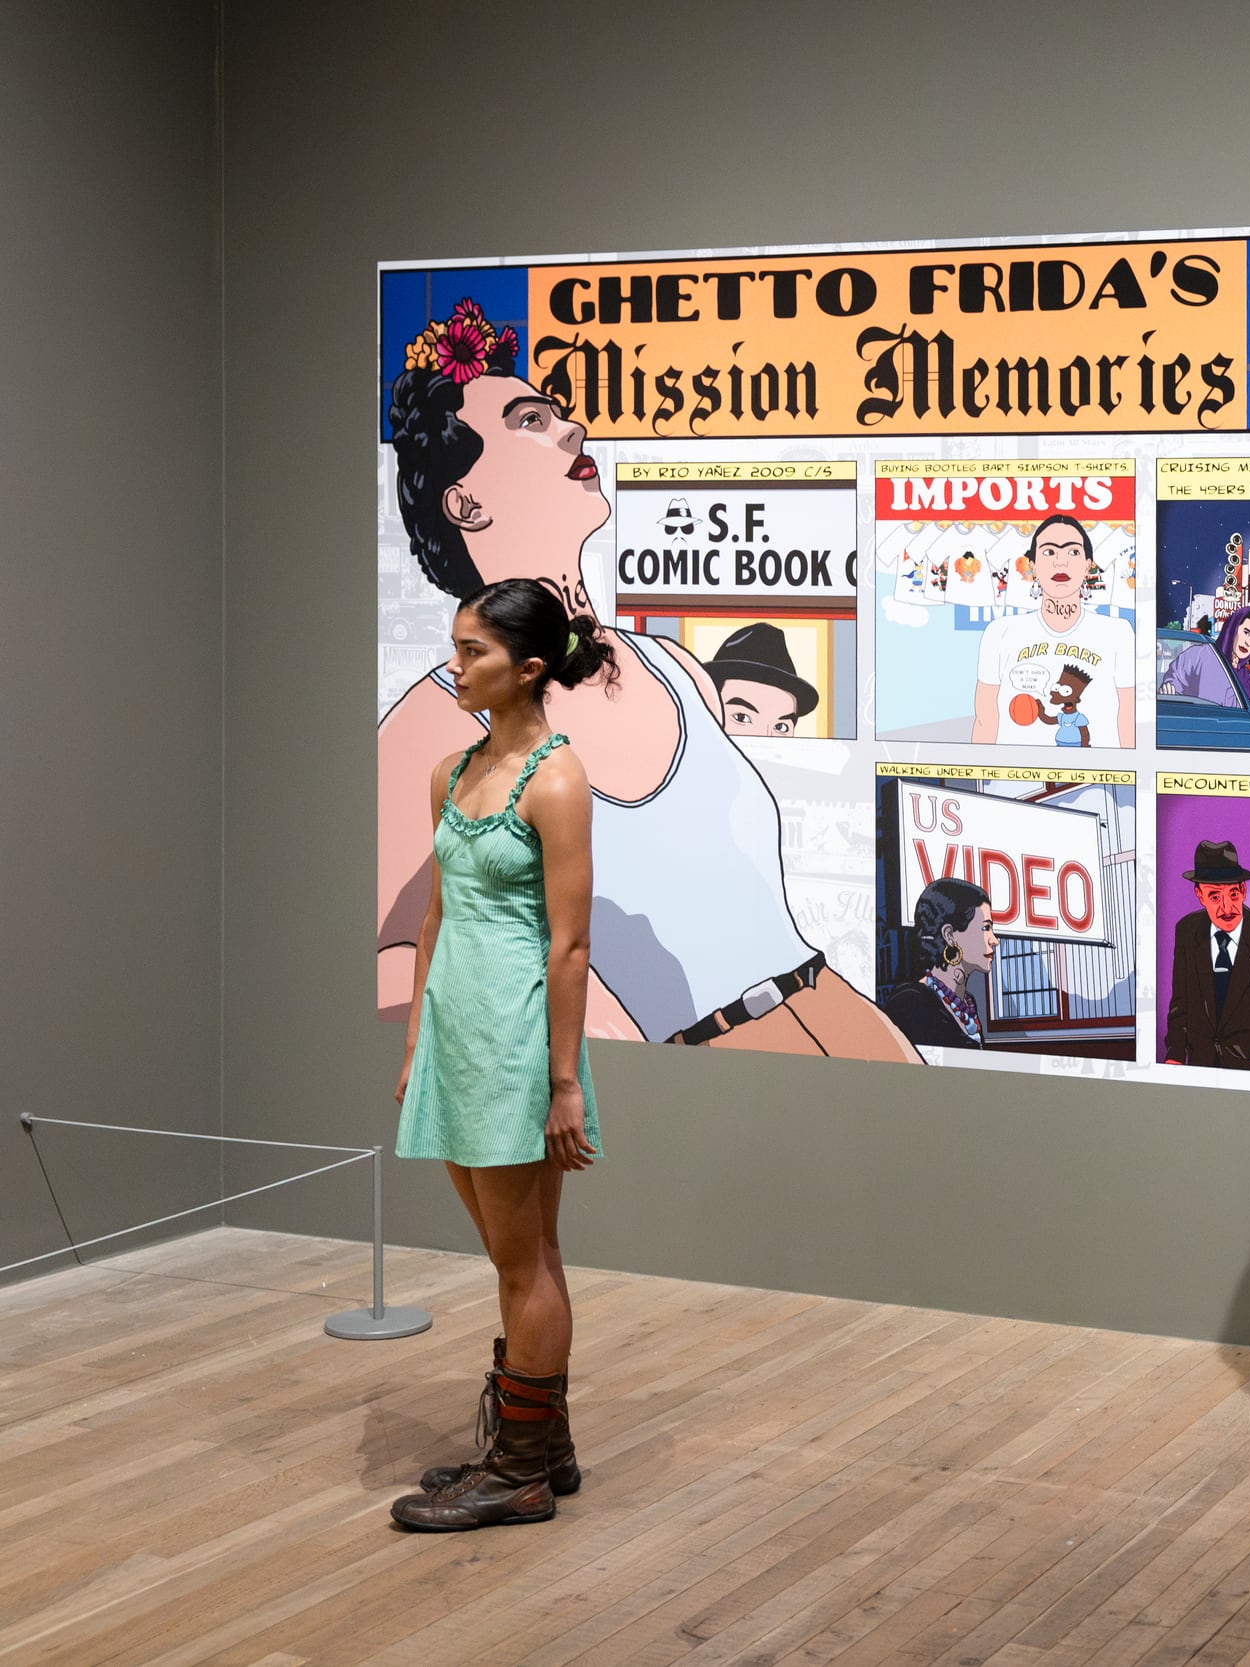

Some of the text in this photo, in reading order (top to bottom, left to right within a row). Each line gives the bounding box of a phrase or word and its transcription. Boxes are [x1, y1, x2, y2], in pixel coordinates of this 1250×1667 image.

[549, 251, 1221, 325] GHETTO FRIDA'S
[533, 322, 1236, 437] Mission Memories
[632, 464, 832, 478] BY RIO YAÑEZ 2009 C/S
[880, 463, 1129, 473] BUYING BOOTLEG BART SIMPSON T-SHIRTS.
[1160, 462, 1230, 473] CRUISING
[890, 476, 1113, 511] IMPORTS
[1168, 485, 1192, 495] THE
[1200, 485, 1245, 495] 49ERS
[708, 503, 770, 543] S.F.
[618, 548, 720, 586] COMIC
[735, 550, 833, 587] BOOK
[1017, 642, 1102, 666] AIR BART
[880, 766, 1133, 783] WALKING UNDER THE GLOW OF US VIDEO.
[909, 792, 963, 836] US
[912, 839, 1094, 932] VIDEO
